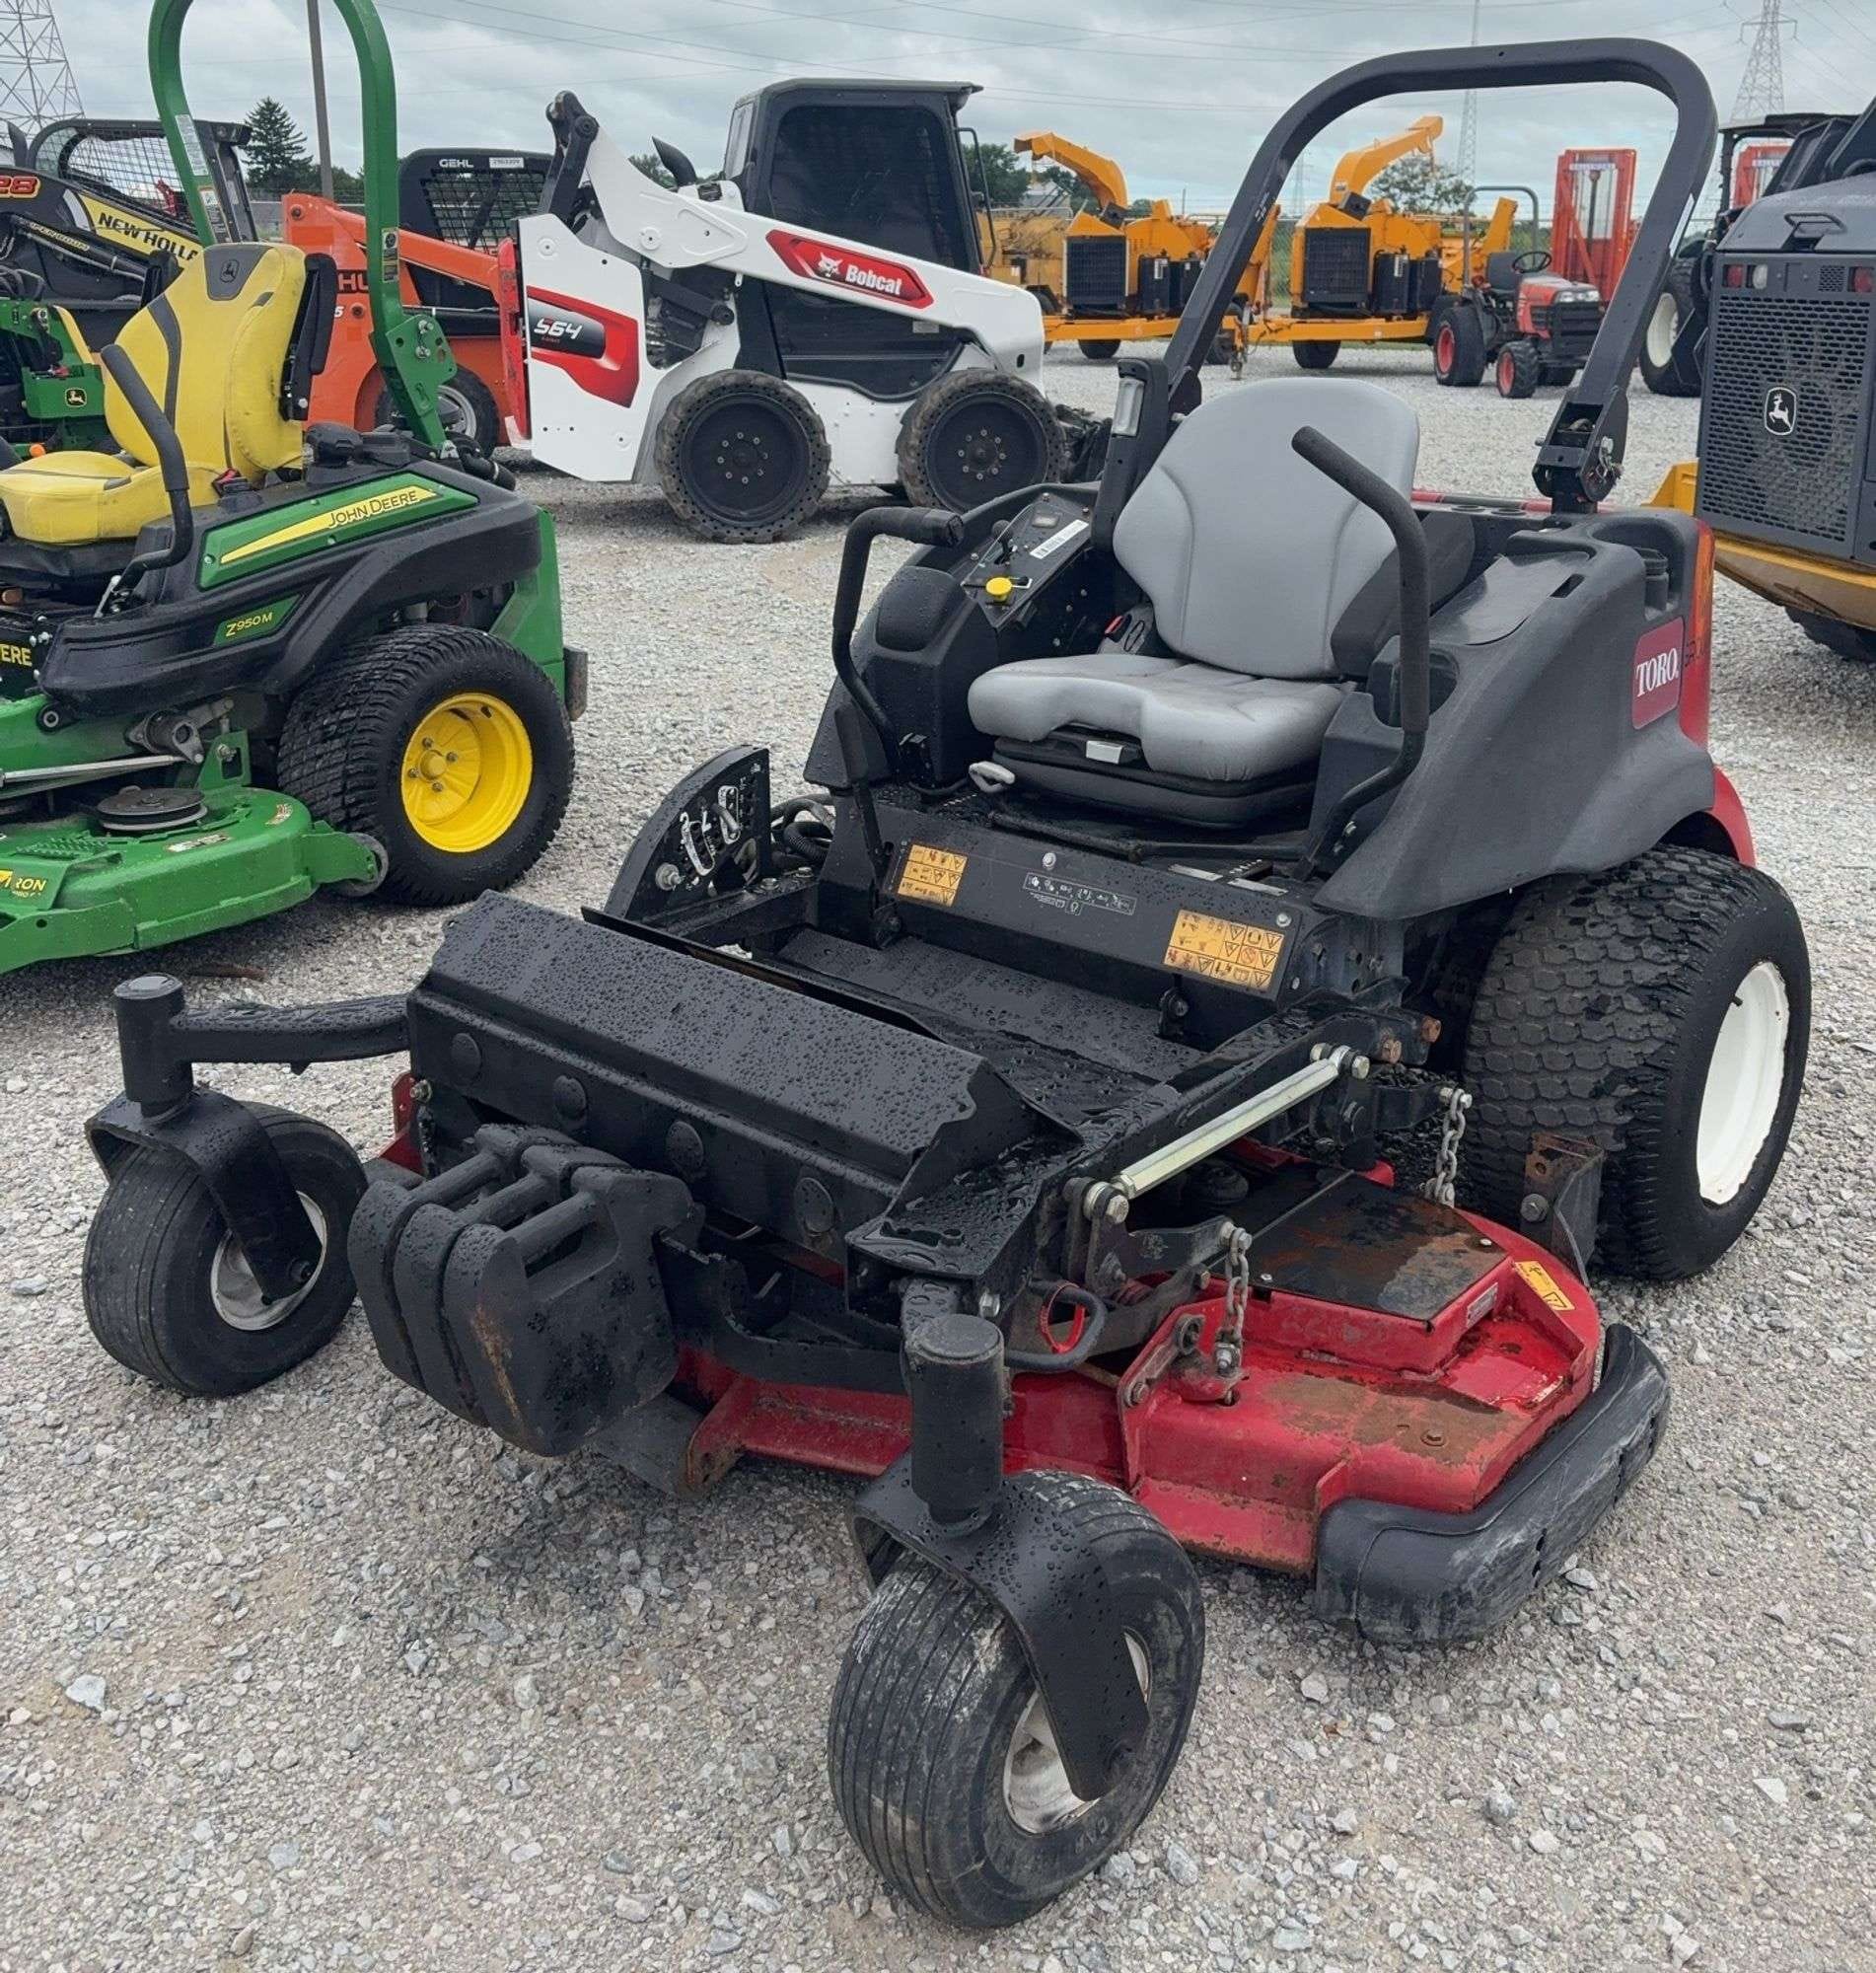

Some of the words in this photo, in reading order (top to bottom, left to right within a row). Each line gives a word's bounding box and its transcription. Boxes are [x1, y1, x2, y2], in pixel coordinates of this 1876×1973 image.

[439, 159, 473, 169] GEHL
[99, 212, 143, 239] NEW
[845, 263, 902, 295] Bobcat
[534, 318, 583, 339] S64
[328, 504, 368, 527] JOHN
[369, 490, 418, 514] DEERE
[226, 612, 273, 637] Z950M
[0, 643, 33, 667] ERE
[1635, 647, 1678, 697] TORO
